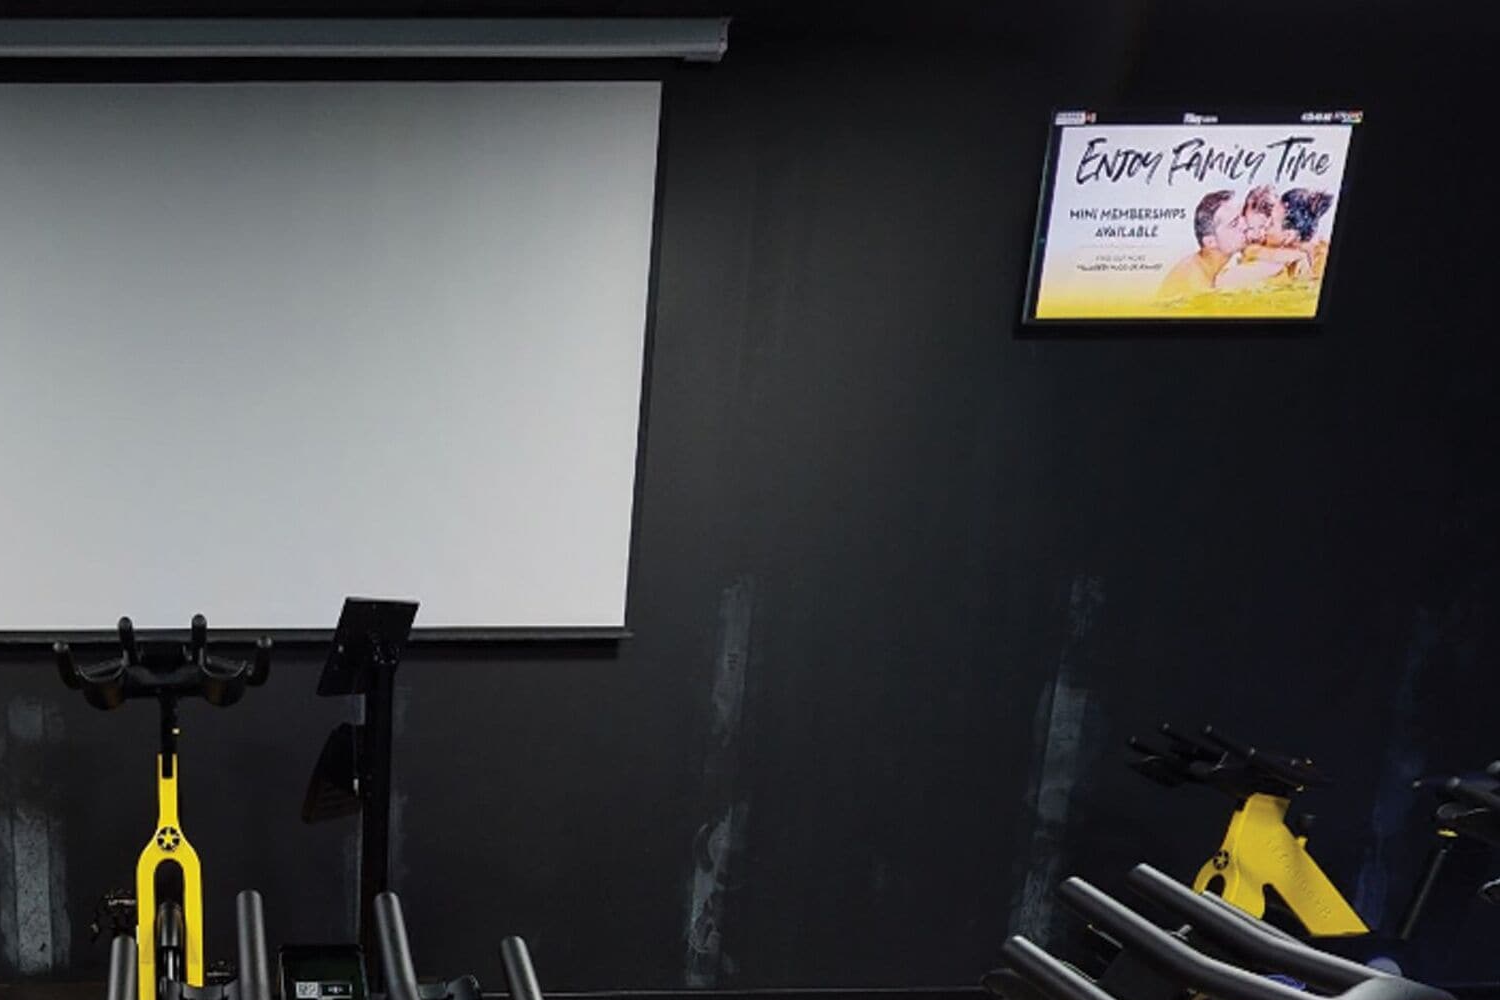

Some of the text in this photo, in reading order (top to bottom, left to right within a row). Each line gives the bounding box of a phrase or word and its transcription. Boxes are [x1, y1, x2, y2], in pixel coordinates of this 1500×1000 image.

[1069, 207, 1187, 220] MINI MEMBERSHIPS
[1095, 225, 1158, 238] AVAILABLE
